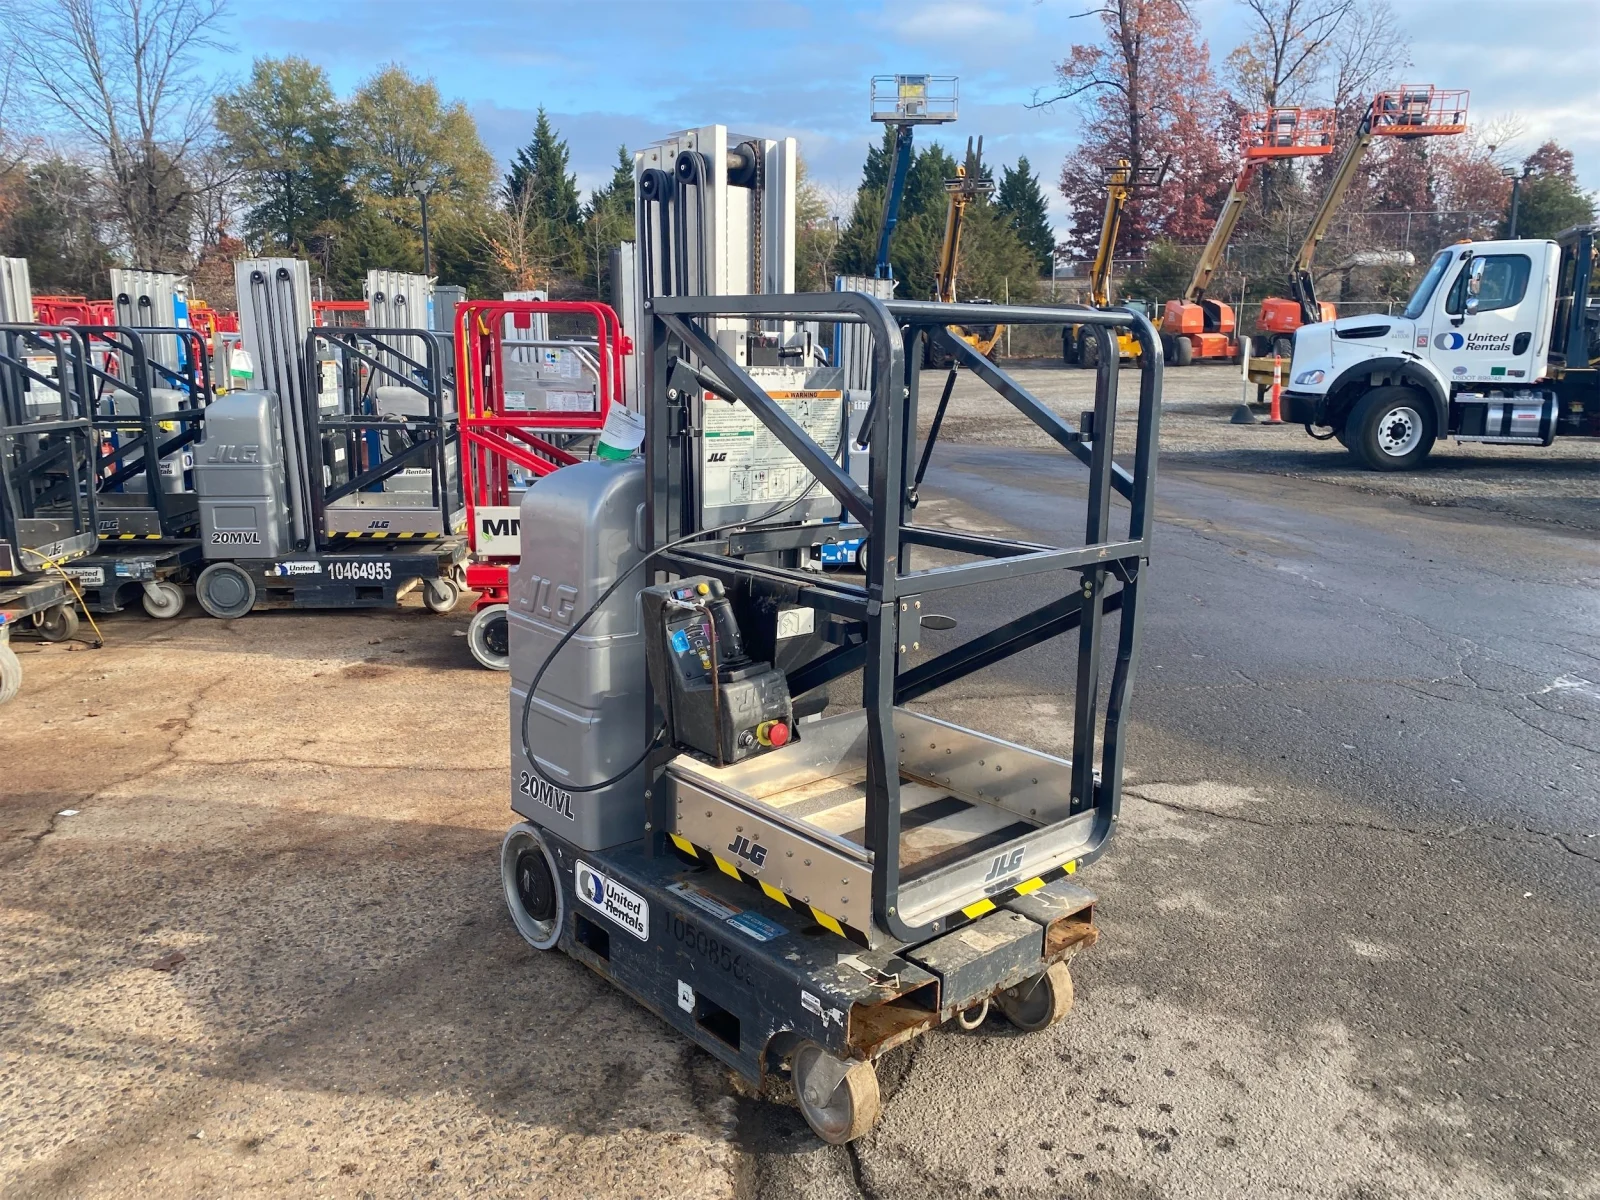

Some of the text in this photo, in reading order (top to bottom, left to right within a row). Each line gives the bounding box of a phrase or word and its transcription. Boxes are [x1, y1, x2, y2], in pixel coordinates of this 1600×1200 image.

[1465, 342, 1511, 351] Rentals
[1467, 333, 1508, 342] United
[206, 444, 259, 463] JLG
[707, 452, 728, 462] JLG
[367, 521, 390, 529] JLG
[211, 532, 261, 544] 20MVL
[289, 564, 316, 572] United
[328, 562, 392, 580] 10464955
[519, 574, 578, 627] JLG
[519, 771, 575, 821] 20MVL
[727, 834, 769, 868] JLG
[984, 845, 1026, 882] JLG
[606, 884, 642, 915] United
[604, 901, 645, 933] Rentals
